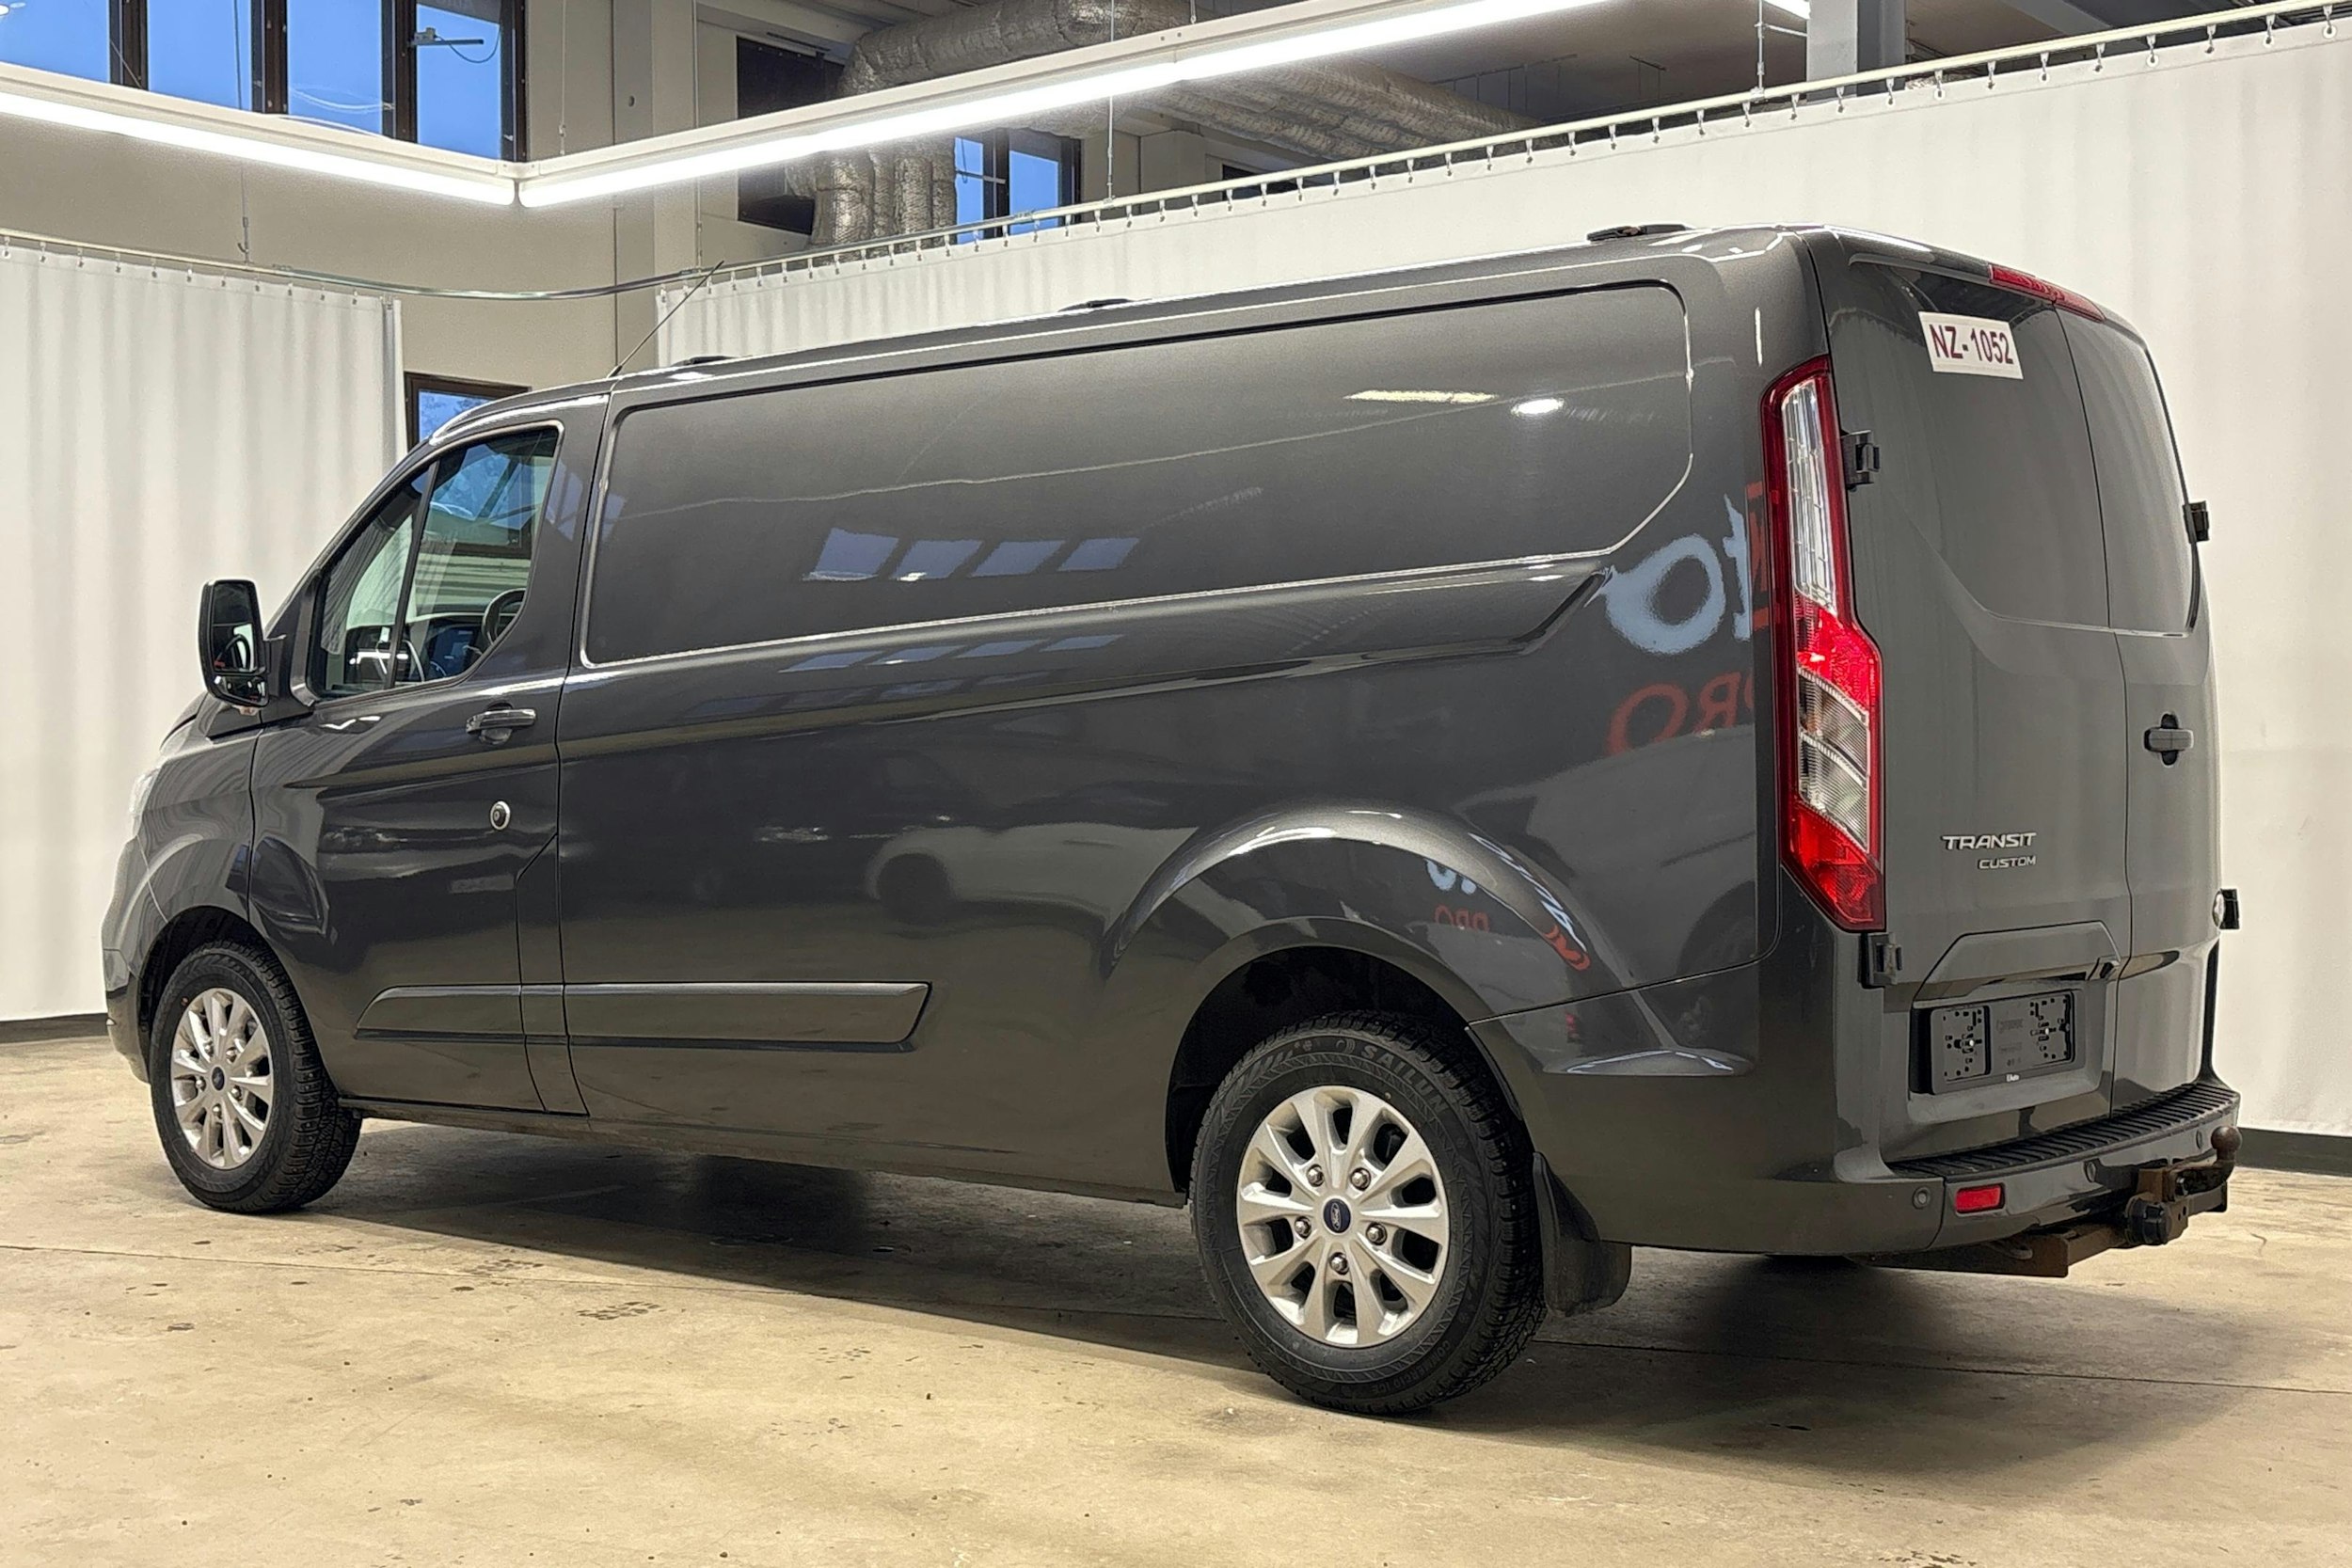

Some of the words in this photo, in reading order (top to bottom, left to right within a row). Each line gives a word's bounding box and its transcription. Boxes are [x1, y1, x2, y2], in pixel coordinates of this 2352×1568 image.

[1930, 324, 2013, 364] NZ-1052
[1942, 832, 2037, 850] TRANSIT
[1978, 856, 2036, 869] CUSTOM
[1360, 1044, 1450, 1114] SAILUN
